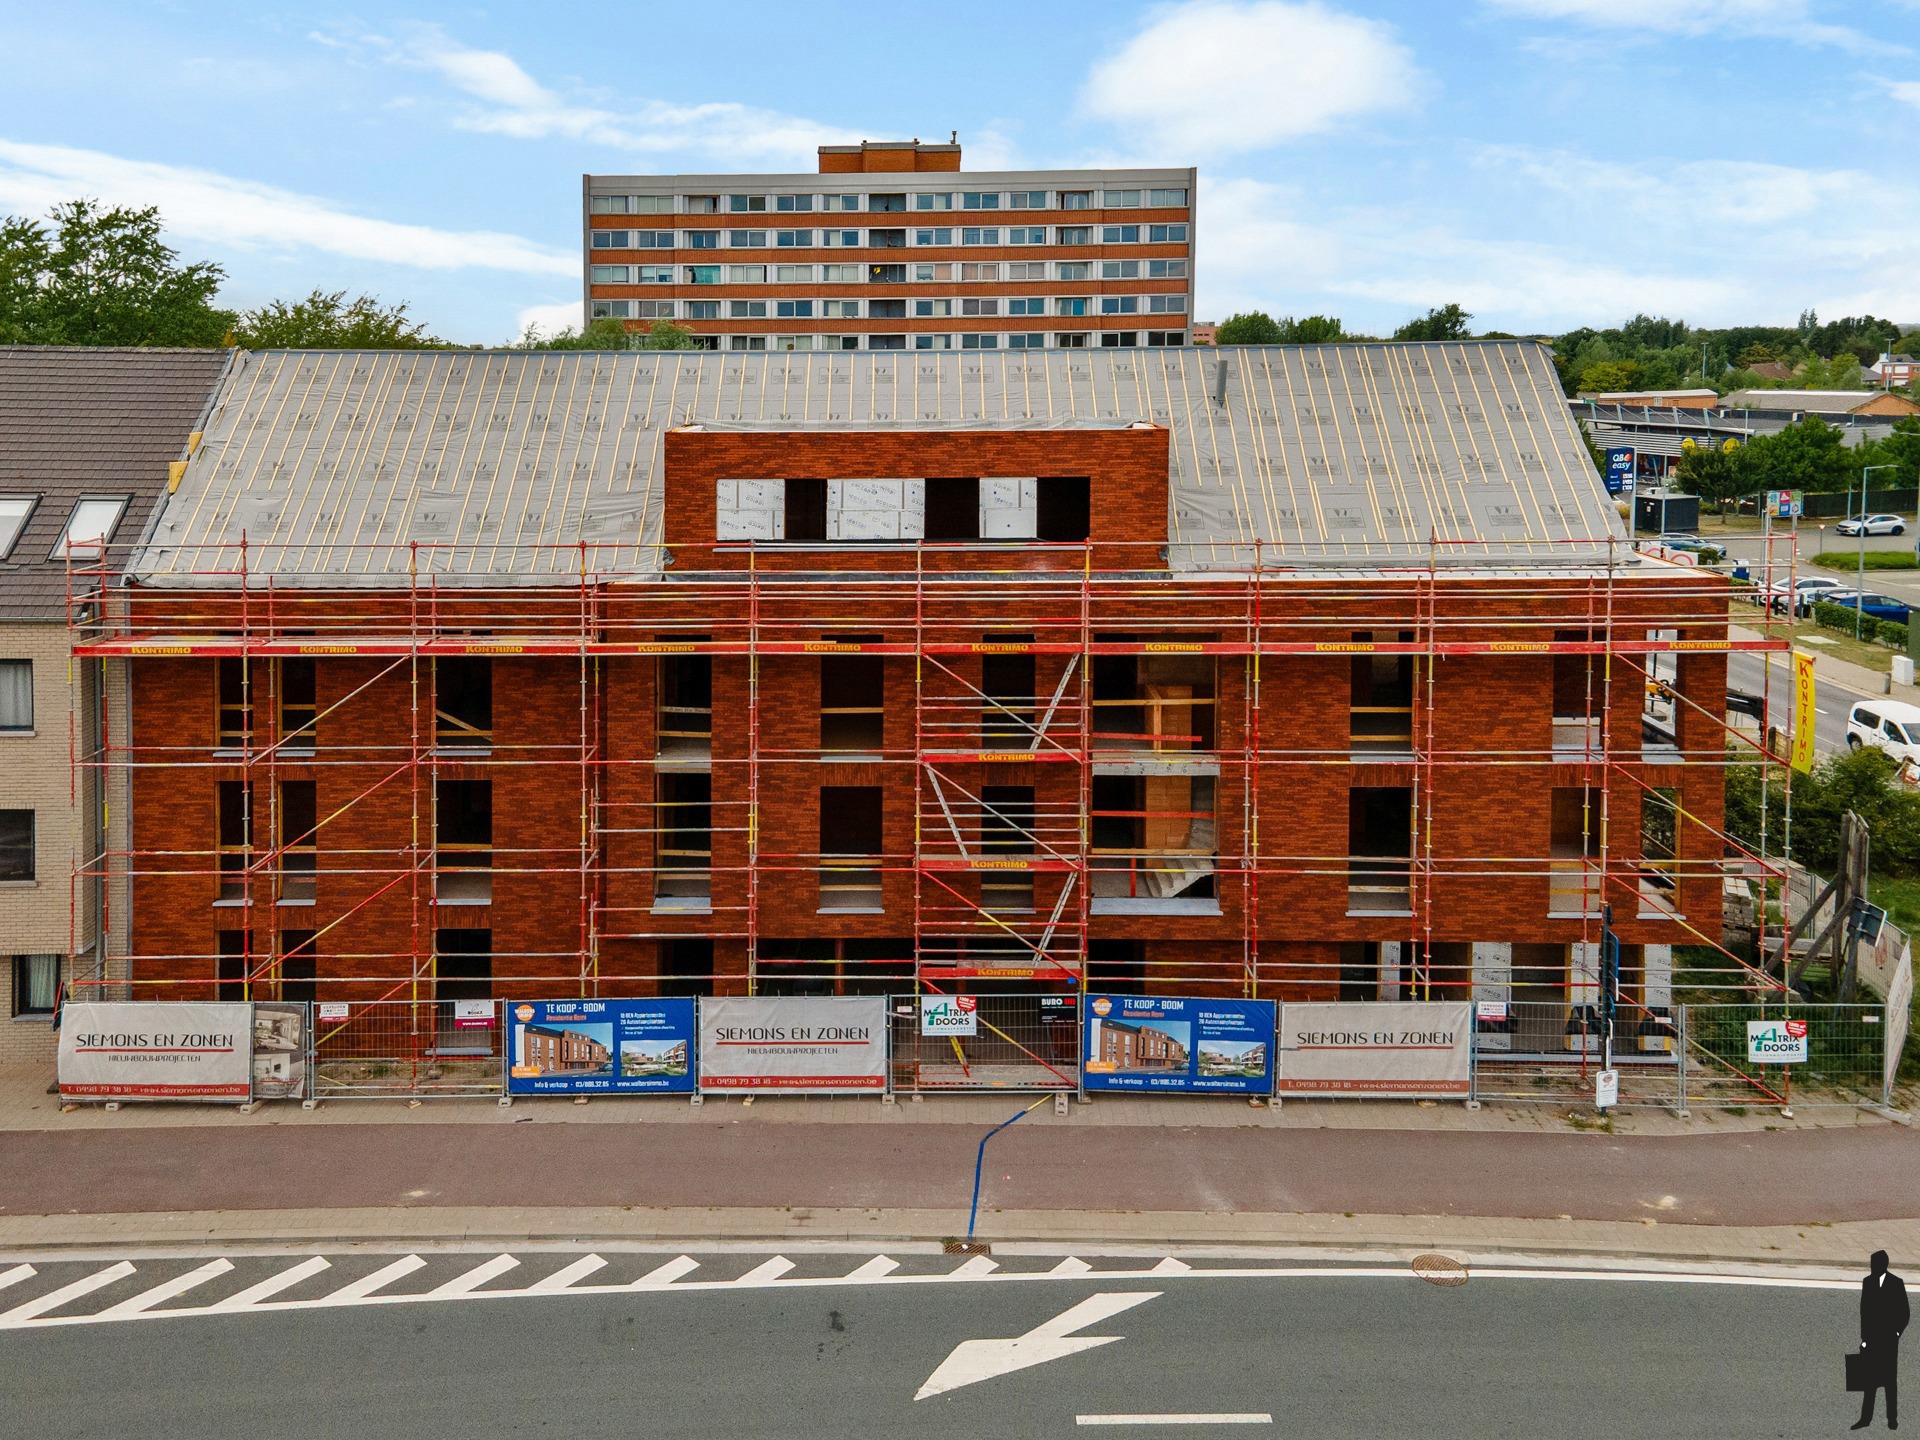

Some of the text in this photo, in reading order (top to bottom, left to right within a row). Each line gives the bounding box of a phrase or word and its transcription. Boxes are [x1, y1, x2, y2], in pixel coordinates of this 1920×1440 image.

[132, 646, 192, 654] KONTRIMO
[972, 644, 1029, 652] KONTRIMO
[1316, 644, 1375, 652] KONTRIMO
[1490, 643, 1550, 651] KONTRIMO
[1800, 661, 1809, 763] KONTRIMO
[977, 968, 1034, 976] KONTRIMO
[546, 1004, 554, 1013] TE
[556, 1004, 576, 1012] KOOP
[583, 1003, 605, 1012] BOOM
[1124, 1000, 1132, 1008] TE
[1134, 1000, 1154, 1009] KOOP
[1162, 1001, 1184, 1010] BOOM
[924, 1003, 969, 1025] MATRIX
[716, 1027, 869, 1040] SIEMONS EN ZONEN
[1297, 1032, 1453, 1044] SIEMONS EN ZONEN
[76, 1033, 233, 1047] SIEMONS EN ZONEN
[1750, 1028, 1800, 1052] MATRIX
[108, 1055, 201, 1063] NIEUWBOUWPROJECTEN
